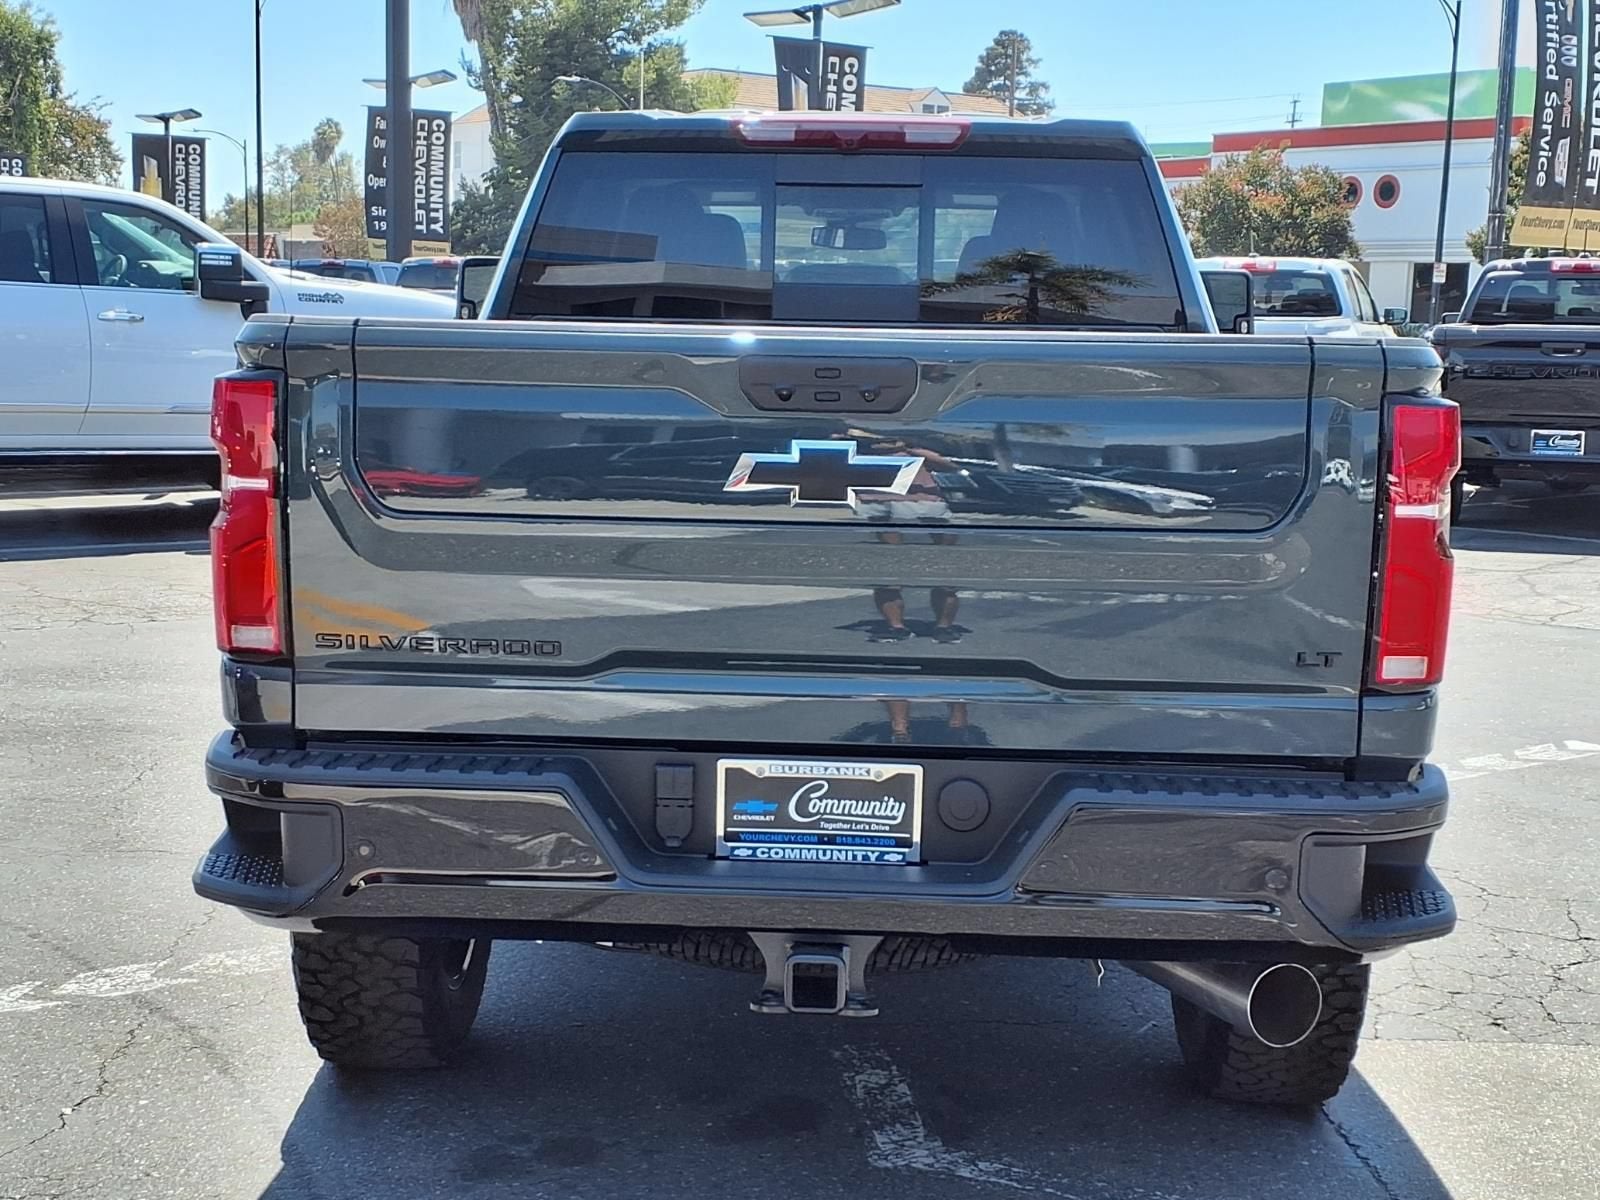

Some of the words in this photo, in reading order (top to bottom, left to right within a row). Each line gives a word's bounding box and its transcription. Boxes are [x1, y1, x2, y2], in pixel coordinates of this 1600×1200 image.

[1535, 90, 1561, 188] Service
[415, 118, 429, 234] CHEVROLET
[430, 119, 446, 235] COMMUNITY
[315, 632, 563, 656] SILVERADO
[1296, 651, 1343, 668] LT
[769, 764, 870, 776] BURBANK
[788, 780, 906, 825] Community
[819, 821, 851, 831] Together
[851, 822, 870, 831] Let's
[870, 824, 890, 832] Drive
[739, 833, 818, 843] YOURCHEVY.COM
[756, 847, 880, 862] COMMUNITY
